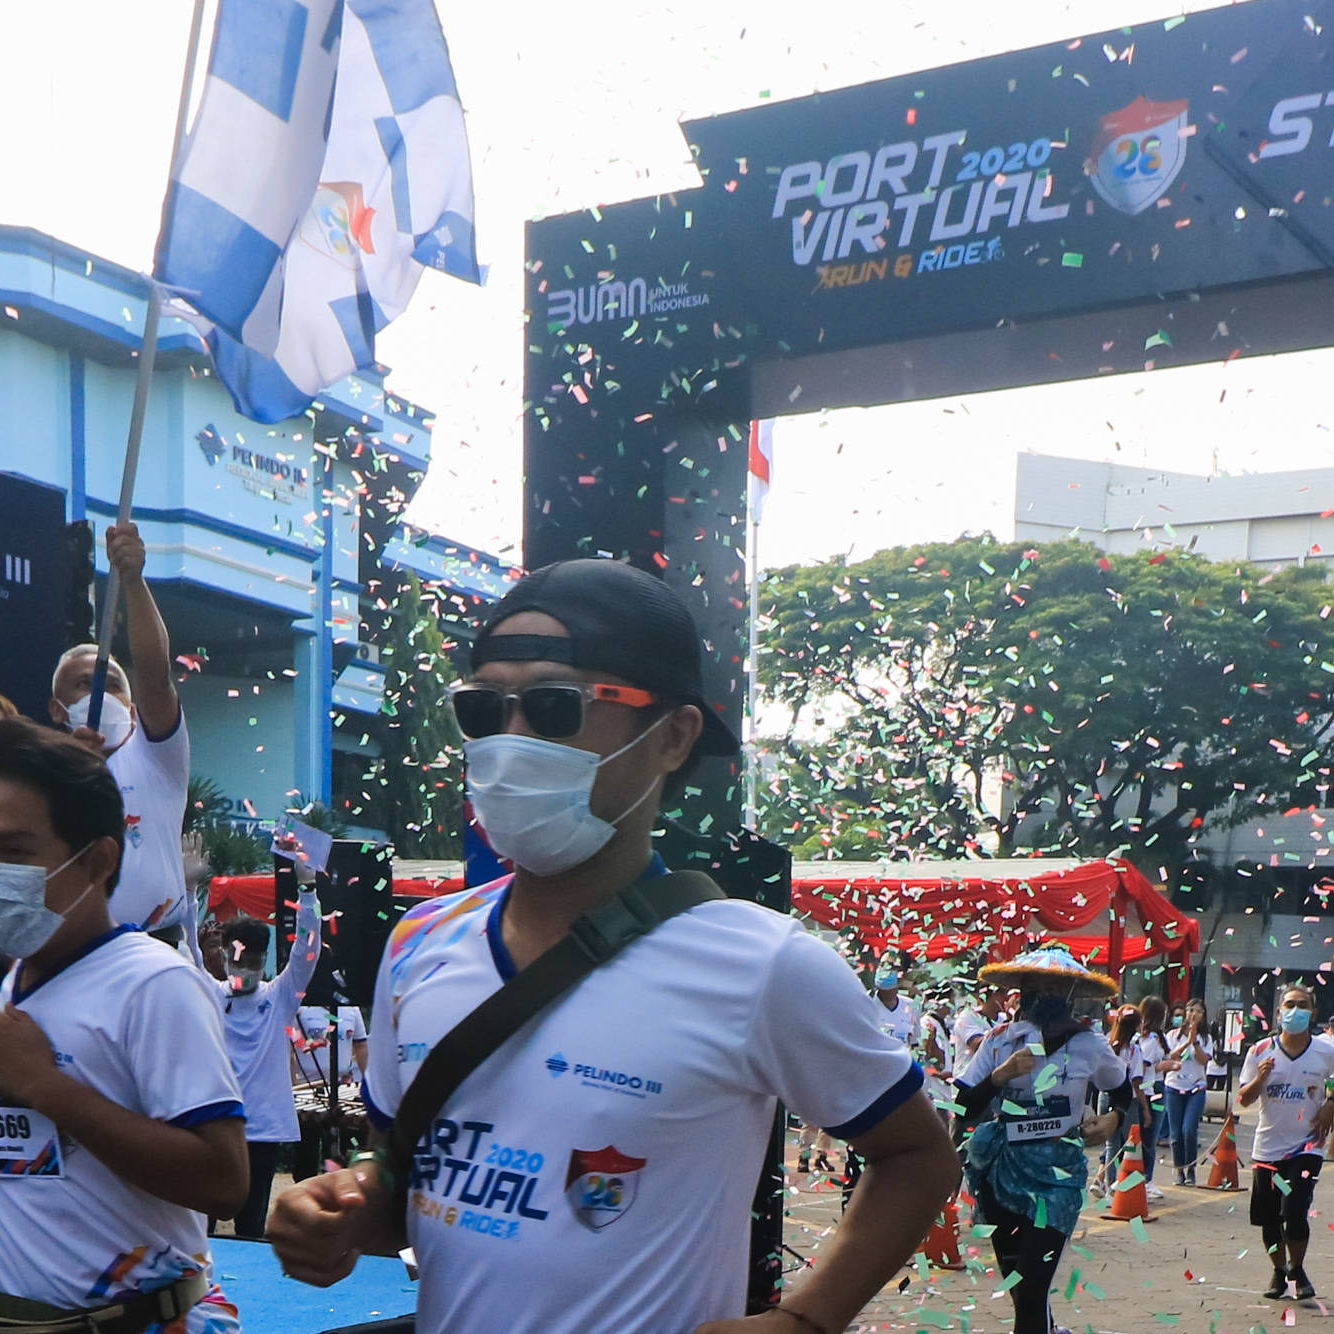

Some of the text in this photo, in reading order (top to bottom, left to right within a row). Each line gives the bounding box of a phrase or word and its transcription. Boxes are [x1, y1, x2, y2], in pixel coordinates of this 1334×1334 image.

[771, 130, 1052, 218] PORT 2020
[791, 168, 1070, 265] VIRTUAL
[824, 257, 888, 289] RUN
[917, 240, 986, 274] RIDE
[650, 294, 709, 313] INDONESIA
[5, 554, 31, 585] III
[574, 1063, 642, 1089] PELINDO
[646, 1080, 662, 1094] III
[484, 1143, 544, 1174] 2020
[411, 1155, 549, 1220] RTUAL
